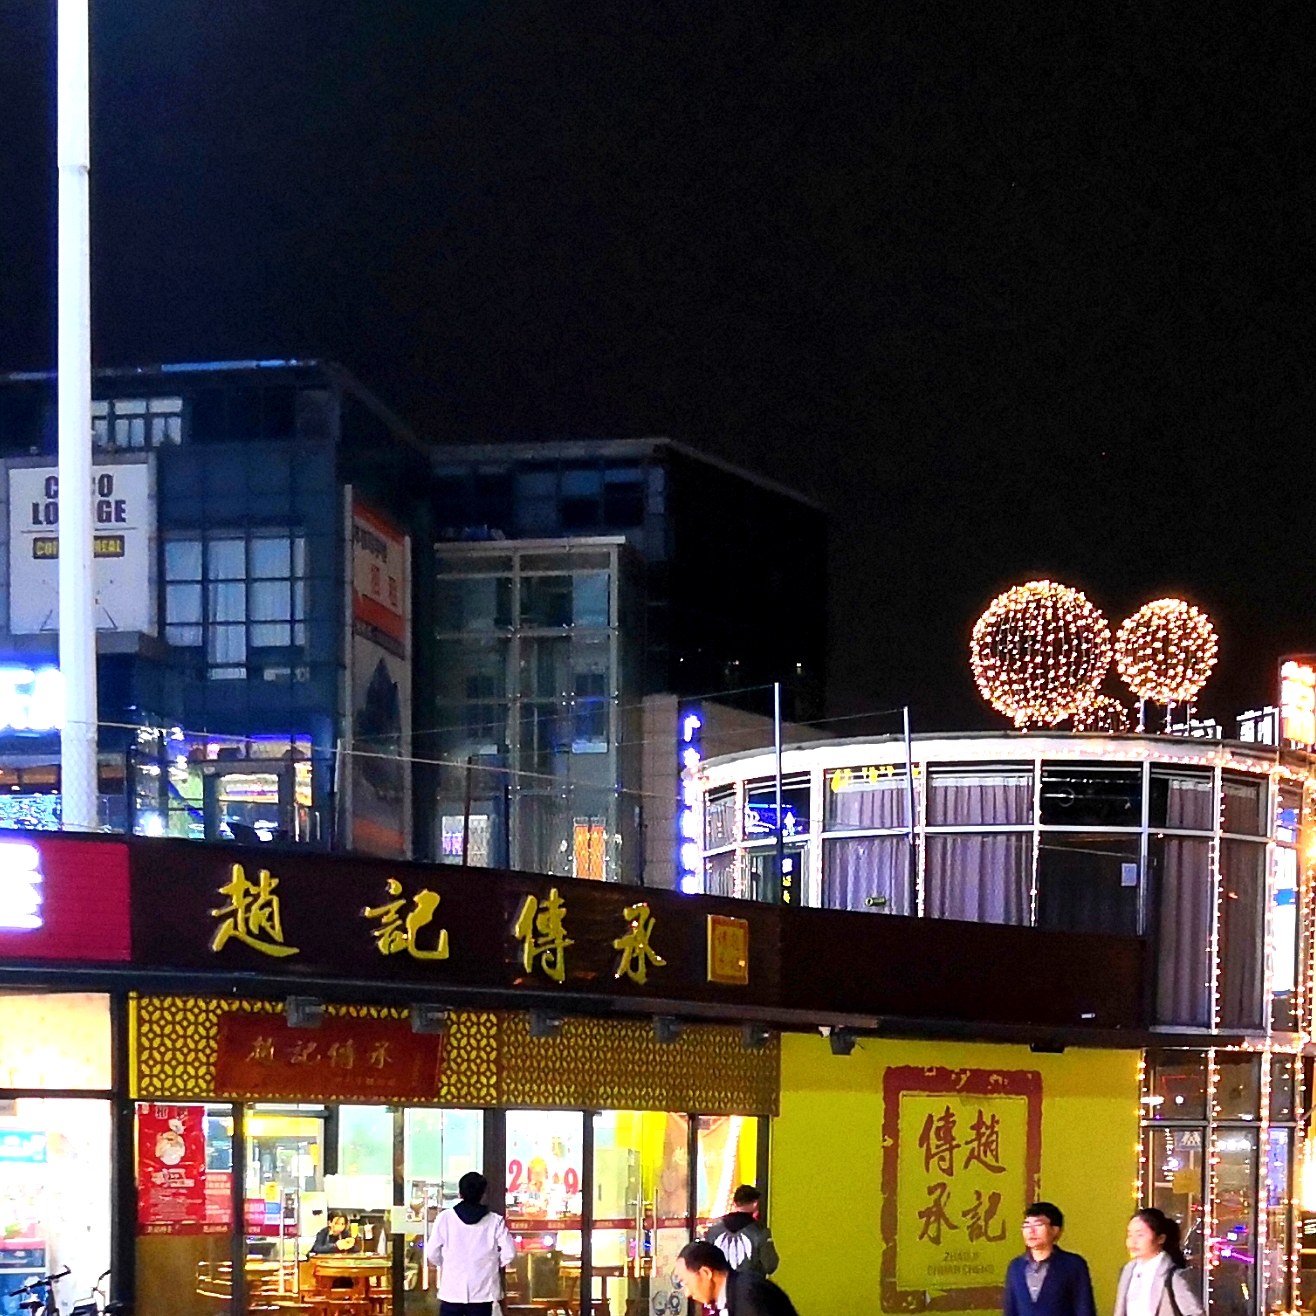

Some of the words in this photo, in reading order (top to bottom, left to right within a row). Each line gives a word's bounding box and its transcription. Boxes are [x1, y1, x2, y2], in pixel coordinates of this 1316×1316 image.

[32, 500, 127, 525] LOGE
[211, 863, 667, 986] 趙記傳承
